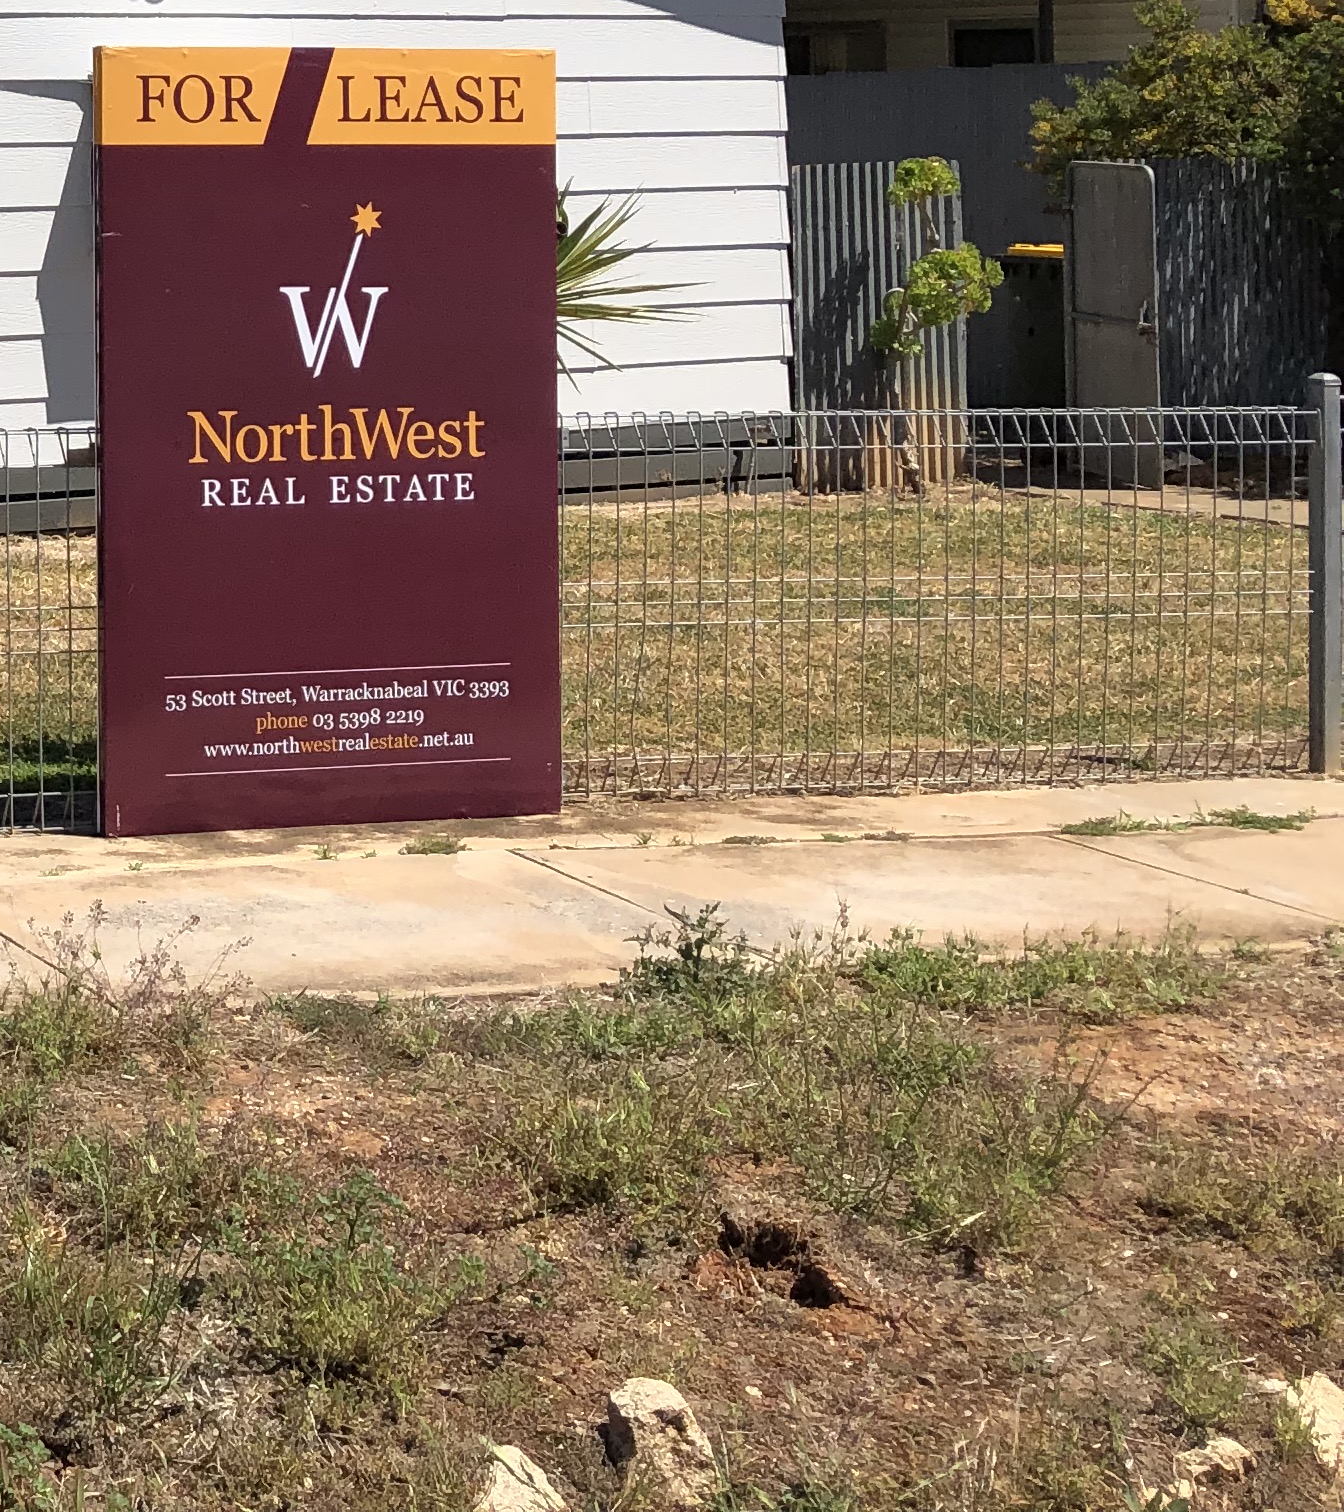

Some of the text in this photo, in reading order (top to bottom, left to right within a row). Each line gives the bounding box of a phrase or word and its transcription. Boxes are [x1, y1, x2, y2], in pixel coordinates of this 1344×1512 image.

[136, 74, 524, 124] FOR LEASE
[186, 404, 486, 464] NorthWest
[201, 472, 475, 507] REAL ESTATE
[165, 679, 510, 712] 53 Scott Street, Warracknabeal VIC 3393
[255, 707, 424, 735] phone 03 5398 2219
[204, 733, 474, 757] www.northwestrealestate.net.au
